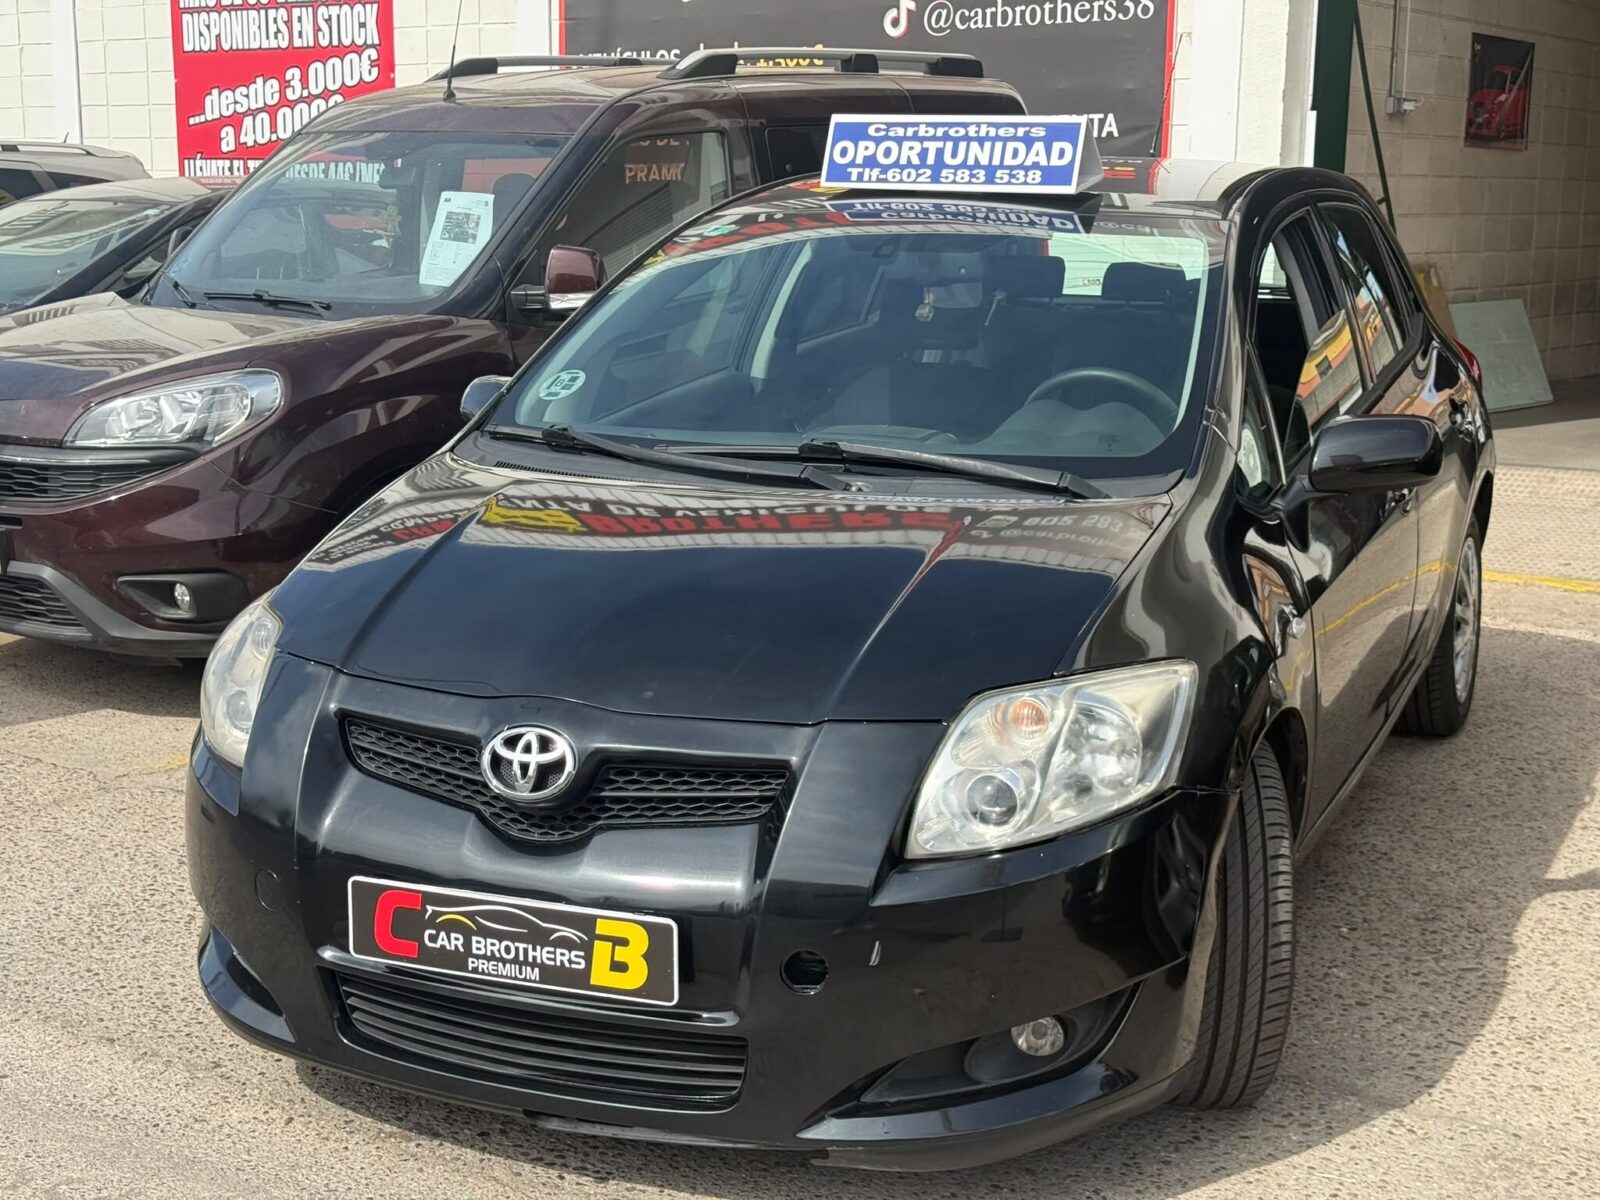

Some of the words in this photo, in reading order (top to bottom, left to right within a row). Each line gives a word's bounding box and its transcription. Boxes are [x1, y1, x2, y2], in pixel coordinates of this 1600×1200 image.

[182, 9, 290, 52] DISPONIBLES
[292, 6, 315, 48] EN
[317, 3, 381, 48] STOCK
[923, 0, 1155, 36] @carbrothers38
[188, 73, 281, 126] ...desde
[284, 47, 380, 101] 3.000€
[220, 125, 236, 153] a
[867, 123, 1047, 138] Carbrothers
[832, 141, 1074, 167] OPORTUNIDAD
[846, 167, 932, 183] Tlf-602
[939, 170, 986, 184] 583
[993, 170, 1042, 184] 538
[424, 929, 464, 952] CAR
[471, 936, 586, 970] BROTHERS
[468, 957, 540, 981] PREMIUM
